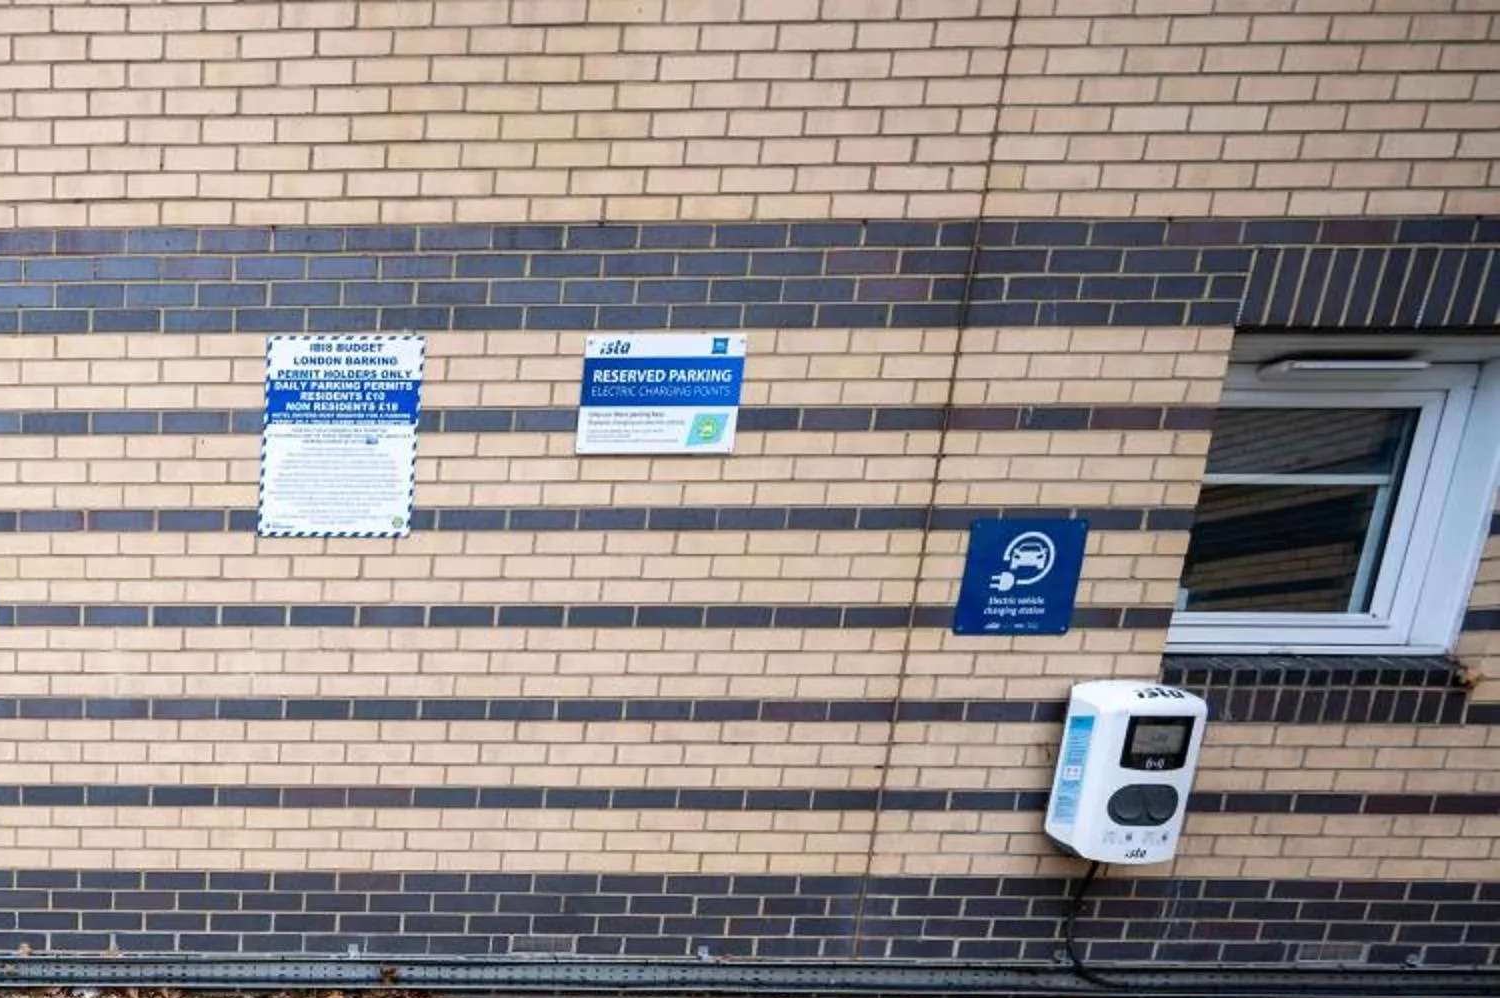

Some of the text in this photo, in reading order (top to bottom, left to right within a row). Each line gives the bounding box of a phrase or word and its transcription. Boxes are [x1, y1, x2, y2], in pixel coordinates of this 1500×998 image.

[310, 343, 383, 353] IBIS BUDGET
[600, 339, 631, 355] ista
[293, 356, 398, 366] LONDON BARKING
[277, 370, 413, 378] PERMIT HOLDERS ONLY
[593, 369, 732, 382] RESERVED PARKING
[274, 382, 412, 390] DAILY PARKING PERMITS
[591, 385, 731, 397] ELECTRIC CHARGING POINTS
[300, 392, 362, 400] RESIDENTS
[286, 402, 311, 411] NON
[314, 402, 375, 411] RESIDENTS
[988, 596, 1045, 605] Electric vehicle
[983, 606, 1045, 616] charging station
